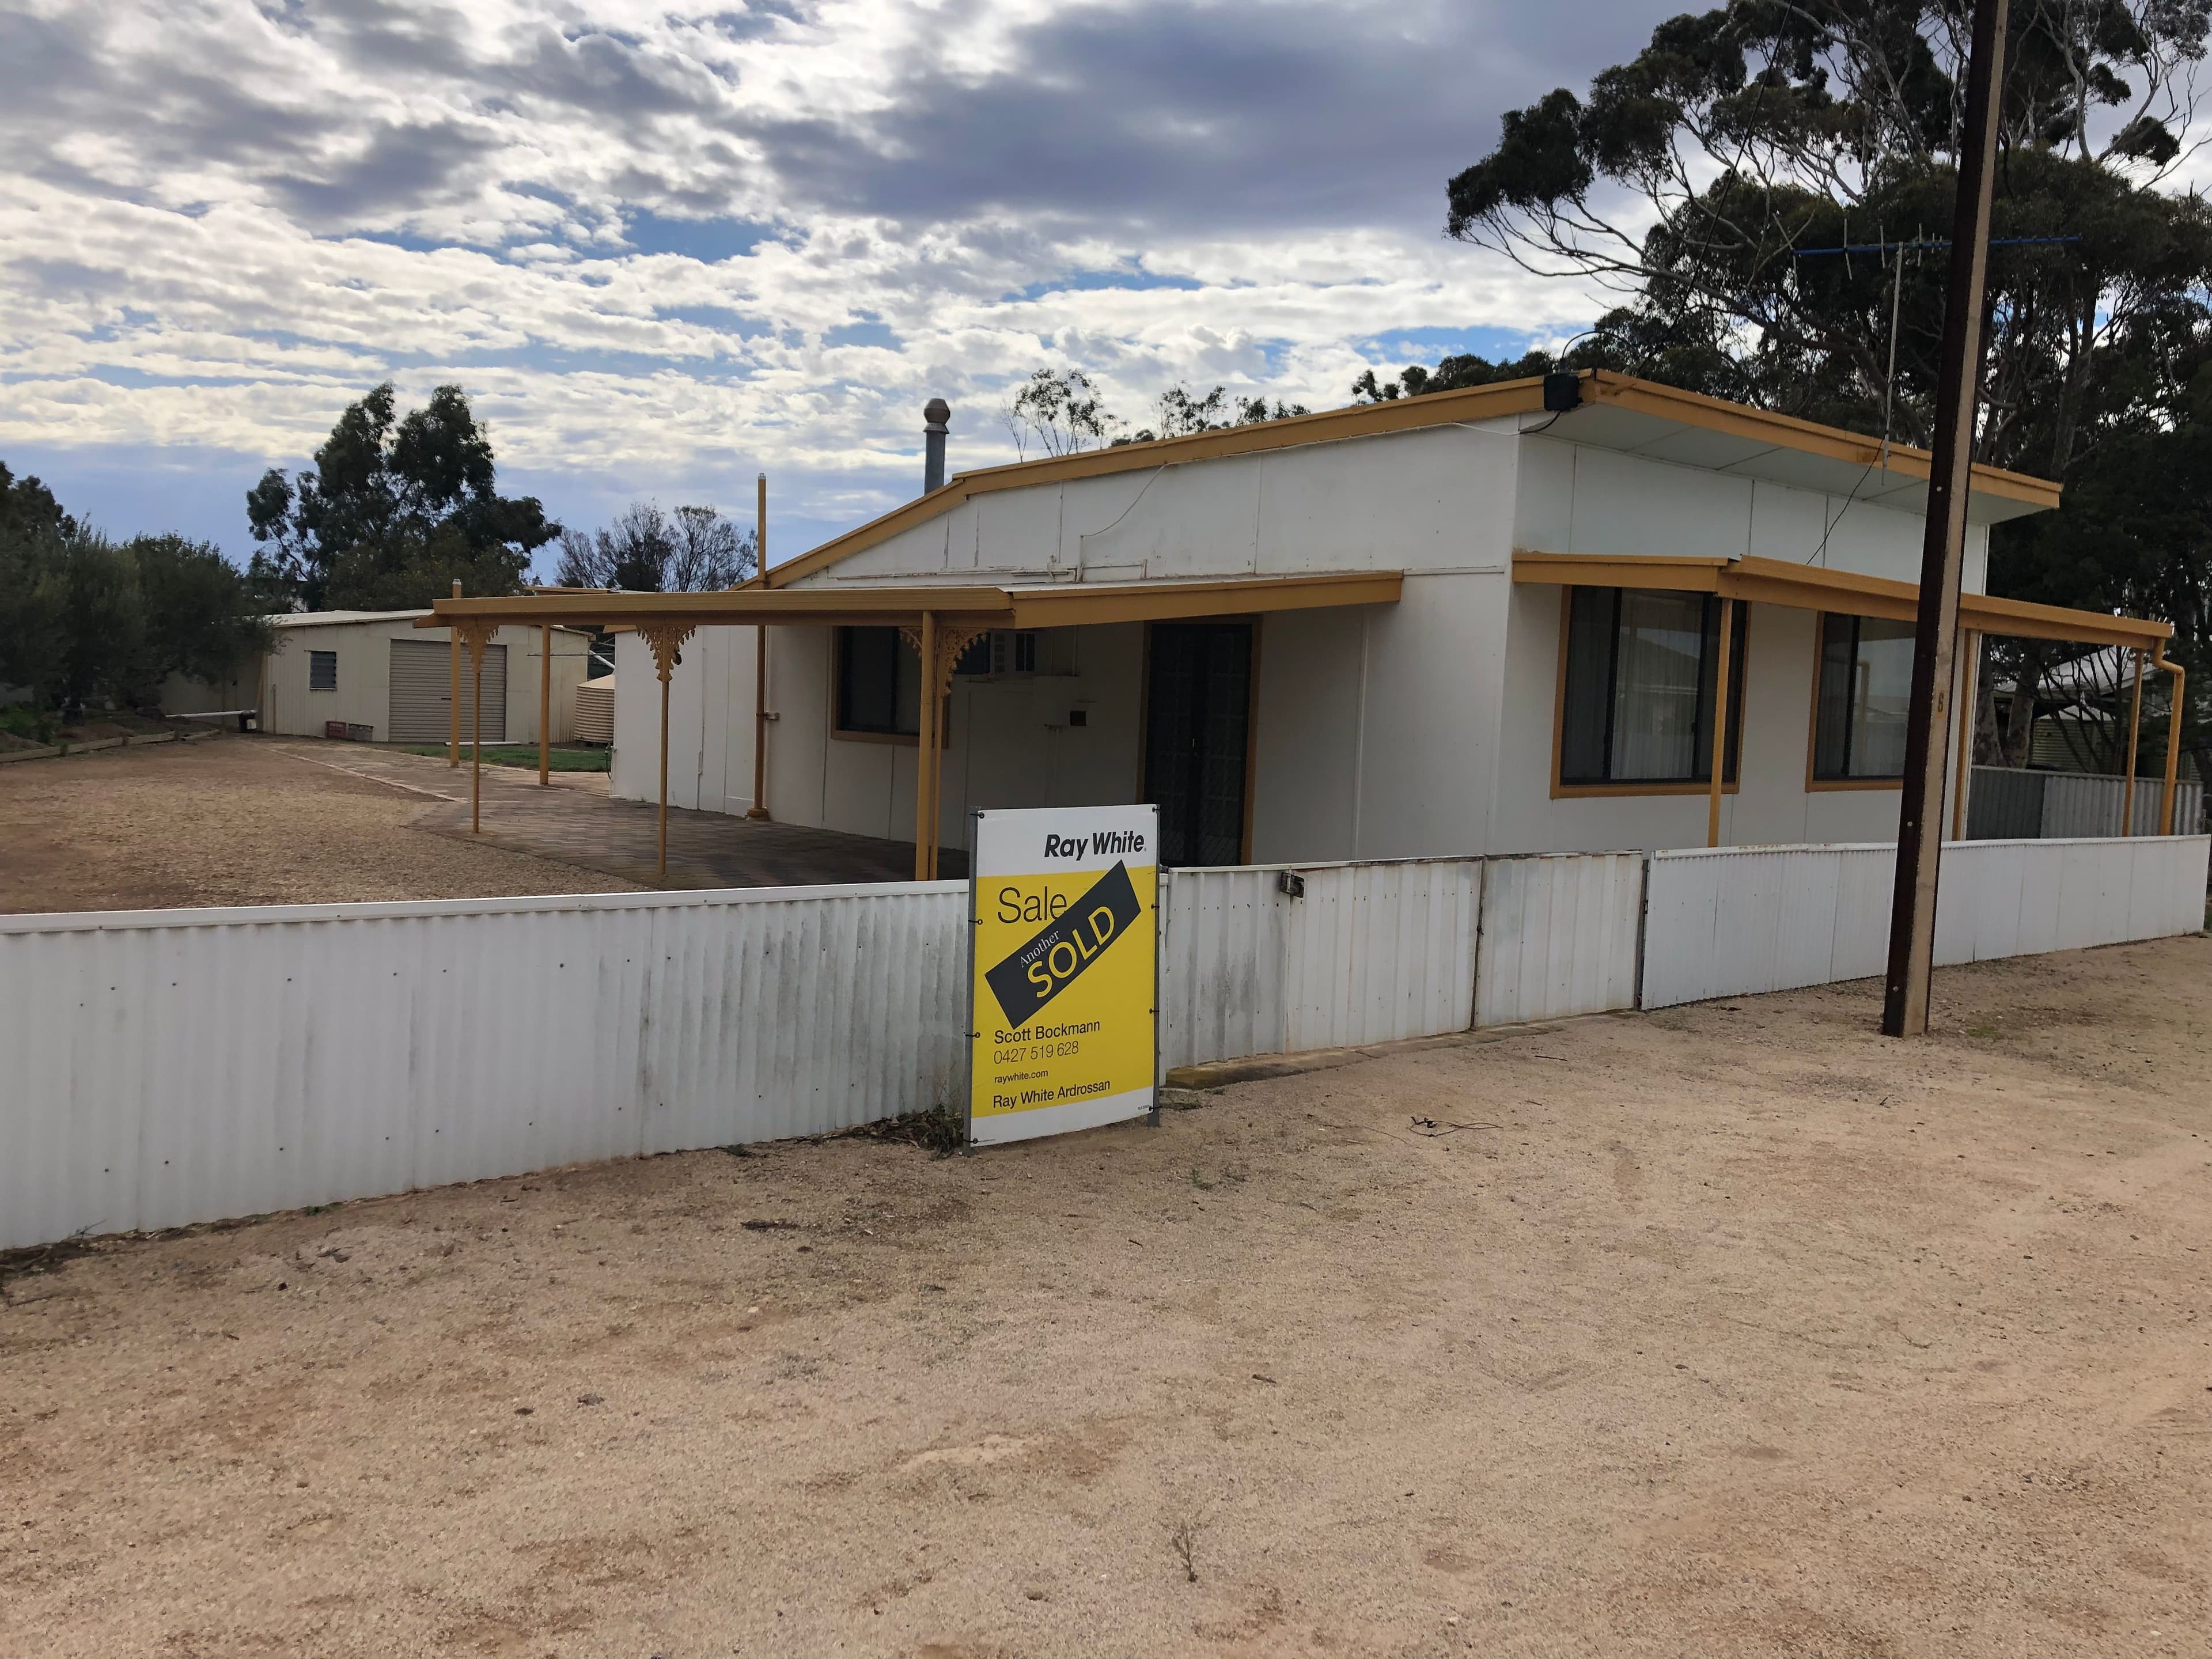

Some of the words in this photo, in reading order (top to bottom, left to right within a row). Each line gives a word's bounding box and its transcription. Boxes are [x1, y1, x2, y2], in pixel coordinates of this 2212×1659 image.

[1044, 834, 1089, 861] Ray
[1093, 830, 1145, 855] White
[997, 885, 1067, 923] Sale
[1019, 930, 1060, 968] Another
[1027, 906, 1115, 998] SOLD
[994, 1028, 1031, 1044] Scott
[1035, 1021, 1100, 1040] Bockmann
[994, 1047, 1027, 1064] 0427
[1030, 1044, 1054, 1060] 519
[1056, 1040, 1079, 1056] 628
[994, 1070, 1048, 1085] raywhite.com
[993, 1094, 1017, 1109] Ray
[1020, 1089, 1055, 1104] White
[1056, 1080, 1111, 1099] Ardrossan
